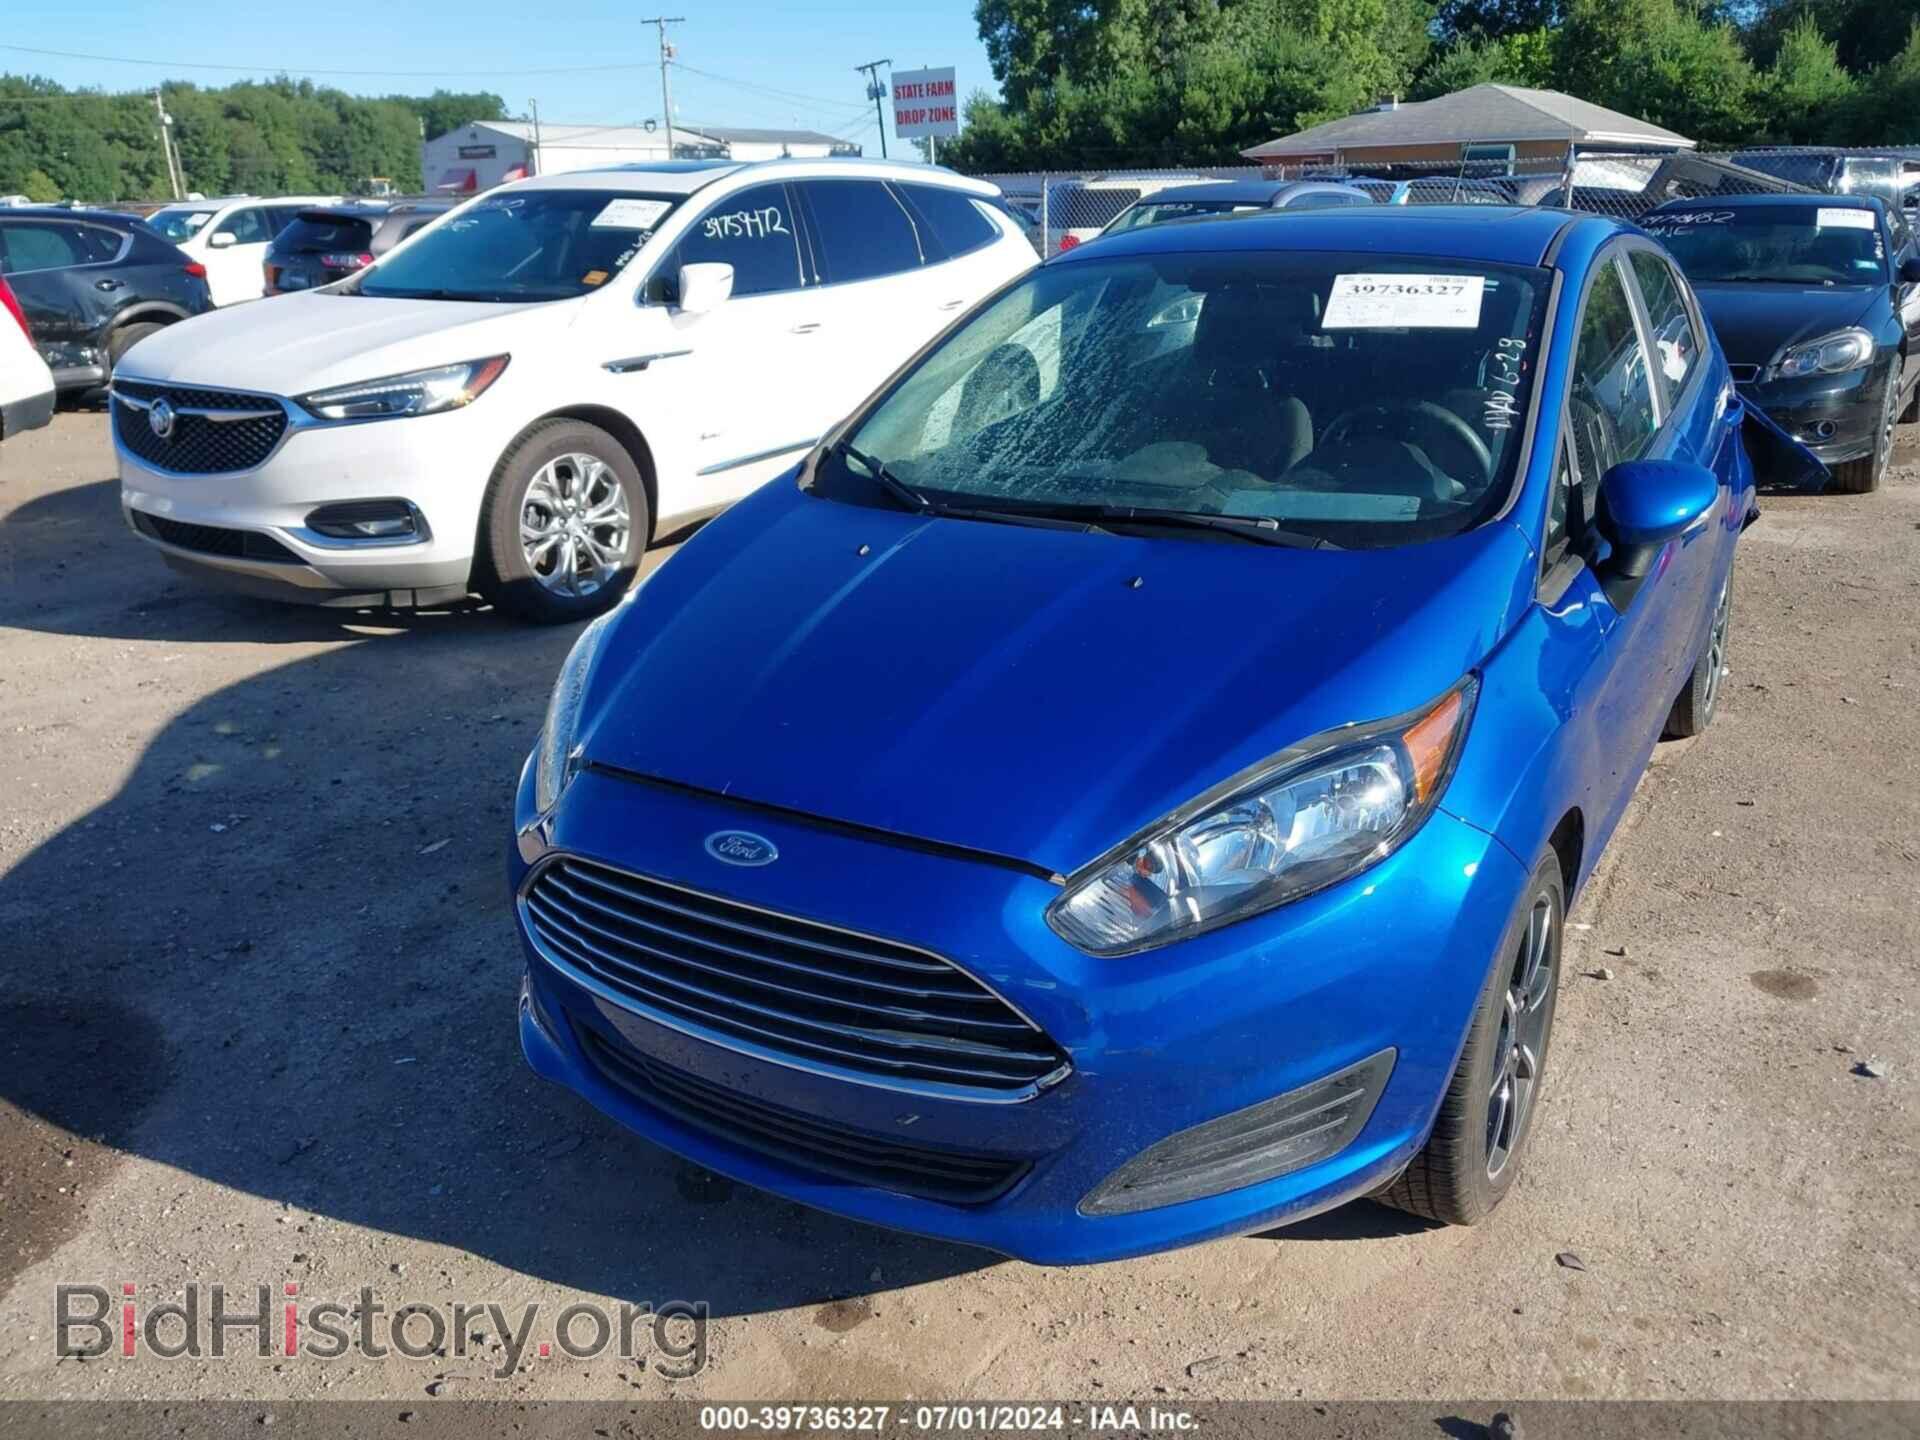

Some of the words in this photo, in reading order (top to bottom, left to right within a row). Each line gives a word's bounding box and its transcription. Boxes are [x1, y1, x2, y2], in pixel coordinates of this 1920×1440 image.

[895, 84, 925, 100] STATE
[926, 80, 954, 97] FARM
[896, 109, 926, 125] DROP
[928, 106, 956, 123] ZONE
[1346, 284, 1465, 296] 39736327
[719, 836, 763, 859] Ford
